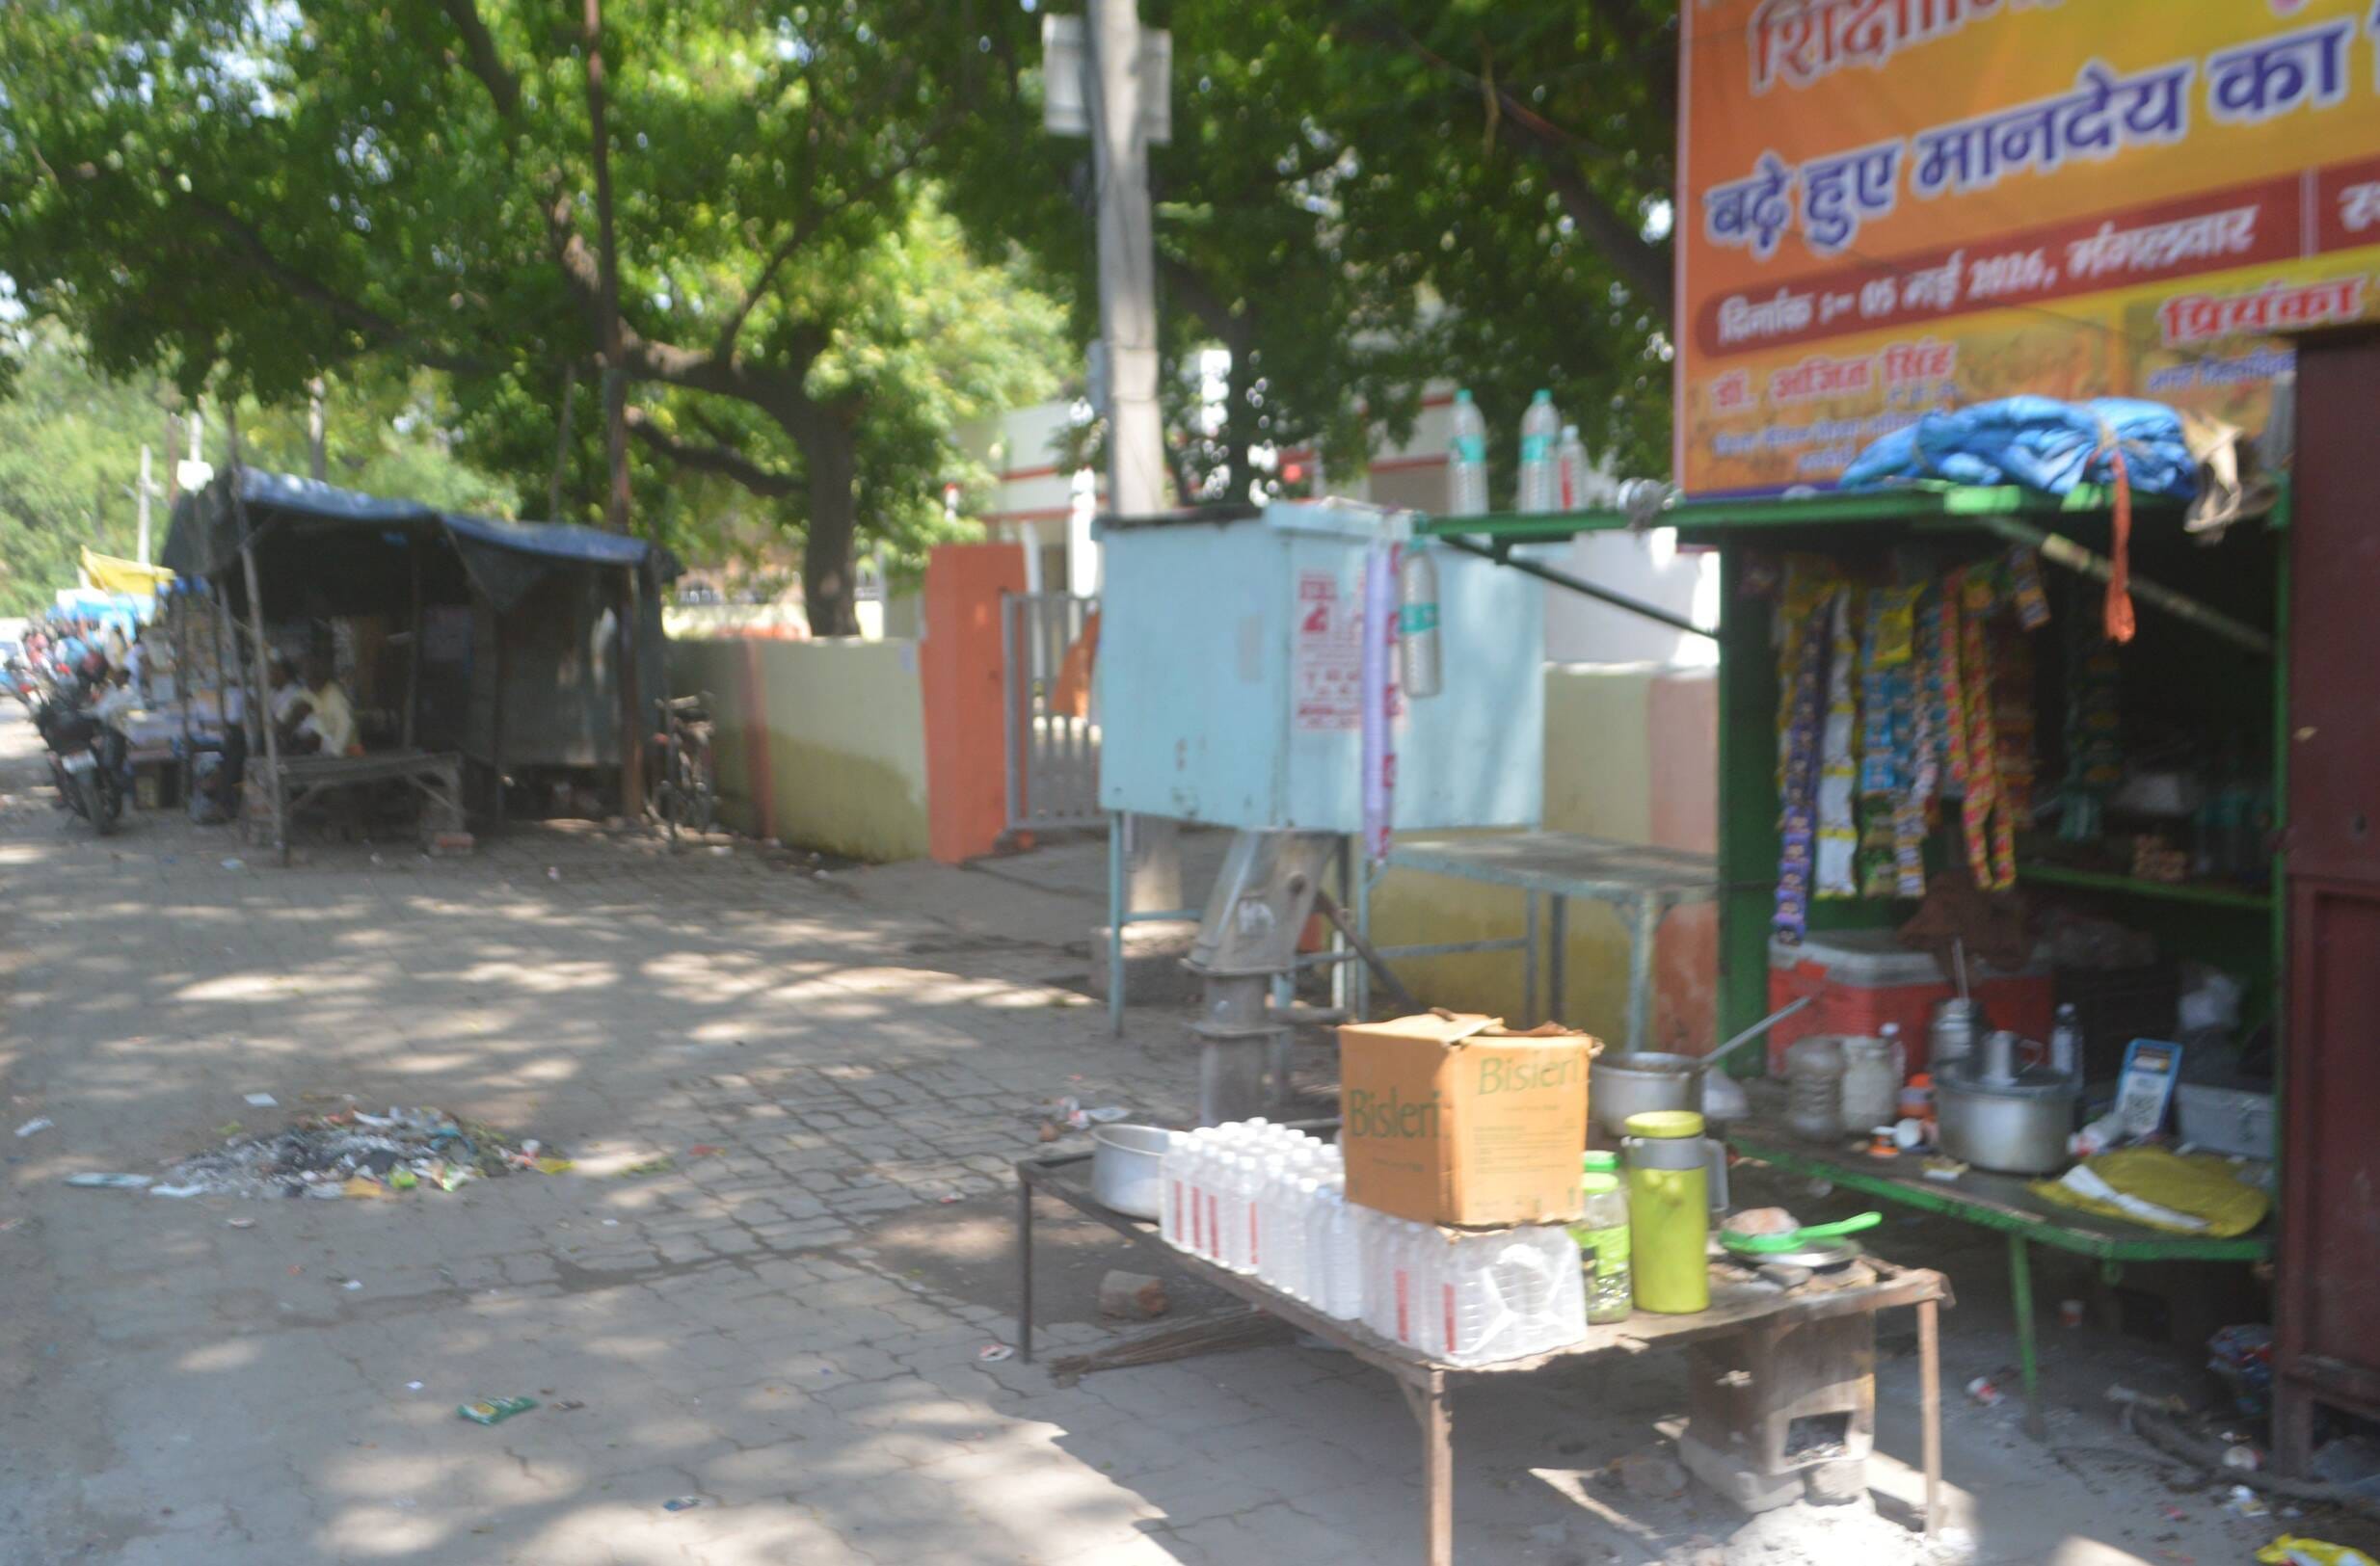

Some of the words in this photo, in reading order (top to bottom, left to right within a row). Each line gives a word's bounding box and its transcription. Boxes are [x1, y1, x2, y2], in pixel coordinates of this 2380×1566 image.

[1706, 152, 1790, 260] बढ़े
[1803, 140, 1903, 256] हुए
[1913, 56, 2194, 197] मानदेय
[2206, 19, 2355, 120] का
[1718, 287, 1814, 344] दिनांक
[1902, 248, 1965, 308] मई
[2068, 204, 2261, 278] मंगलवार
[2157, 277, 2365, 344] प्रियंका
[1477, 1048, 1582, 1096] Bisleri
[1350, 1085, 1442, 1141] Bisleri
